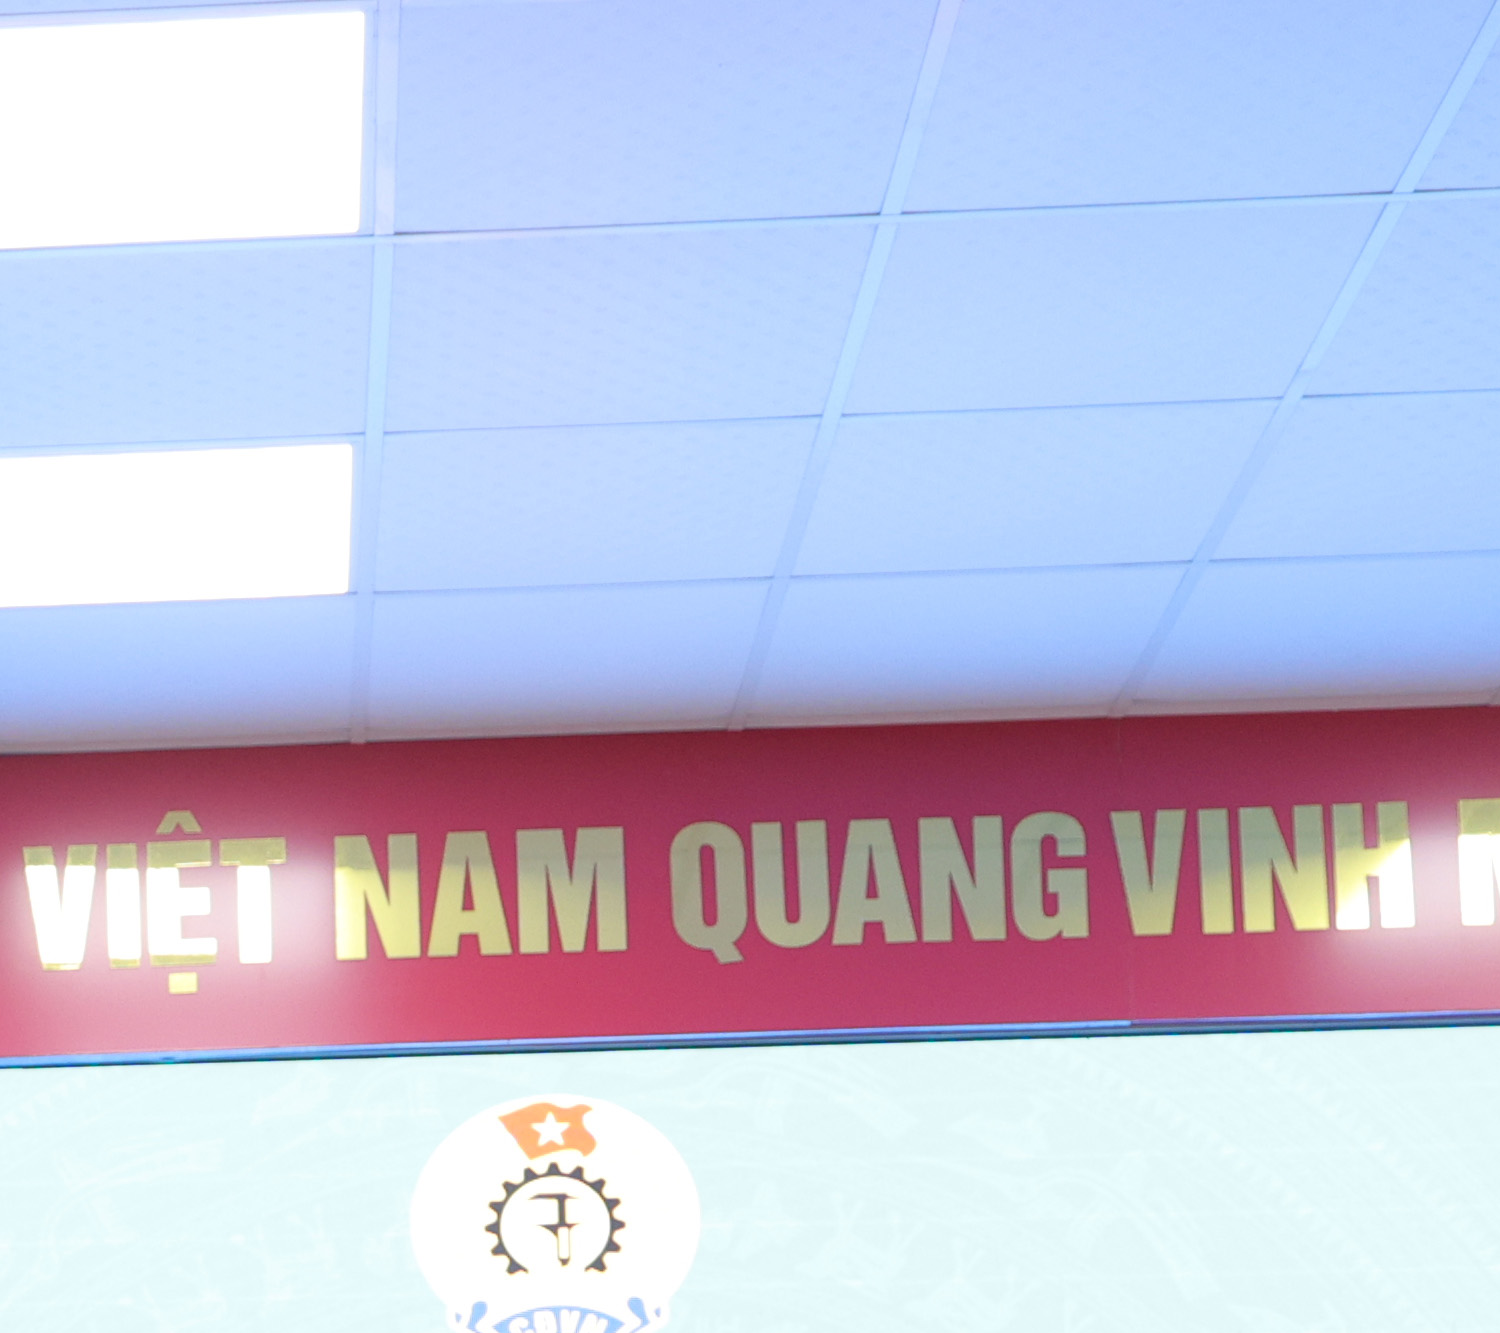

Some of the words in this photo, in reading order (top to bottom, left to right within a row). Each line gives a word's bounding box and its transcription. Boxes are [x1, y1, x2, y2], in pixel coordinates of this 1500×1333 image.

[21, 811, 287, 993] VIỆT
[333, 826, 628, 960] NAM
[668, 810, 1089, 963] QUANG
[1110, 800, 1416, 935] VINH
